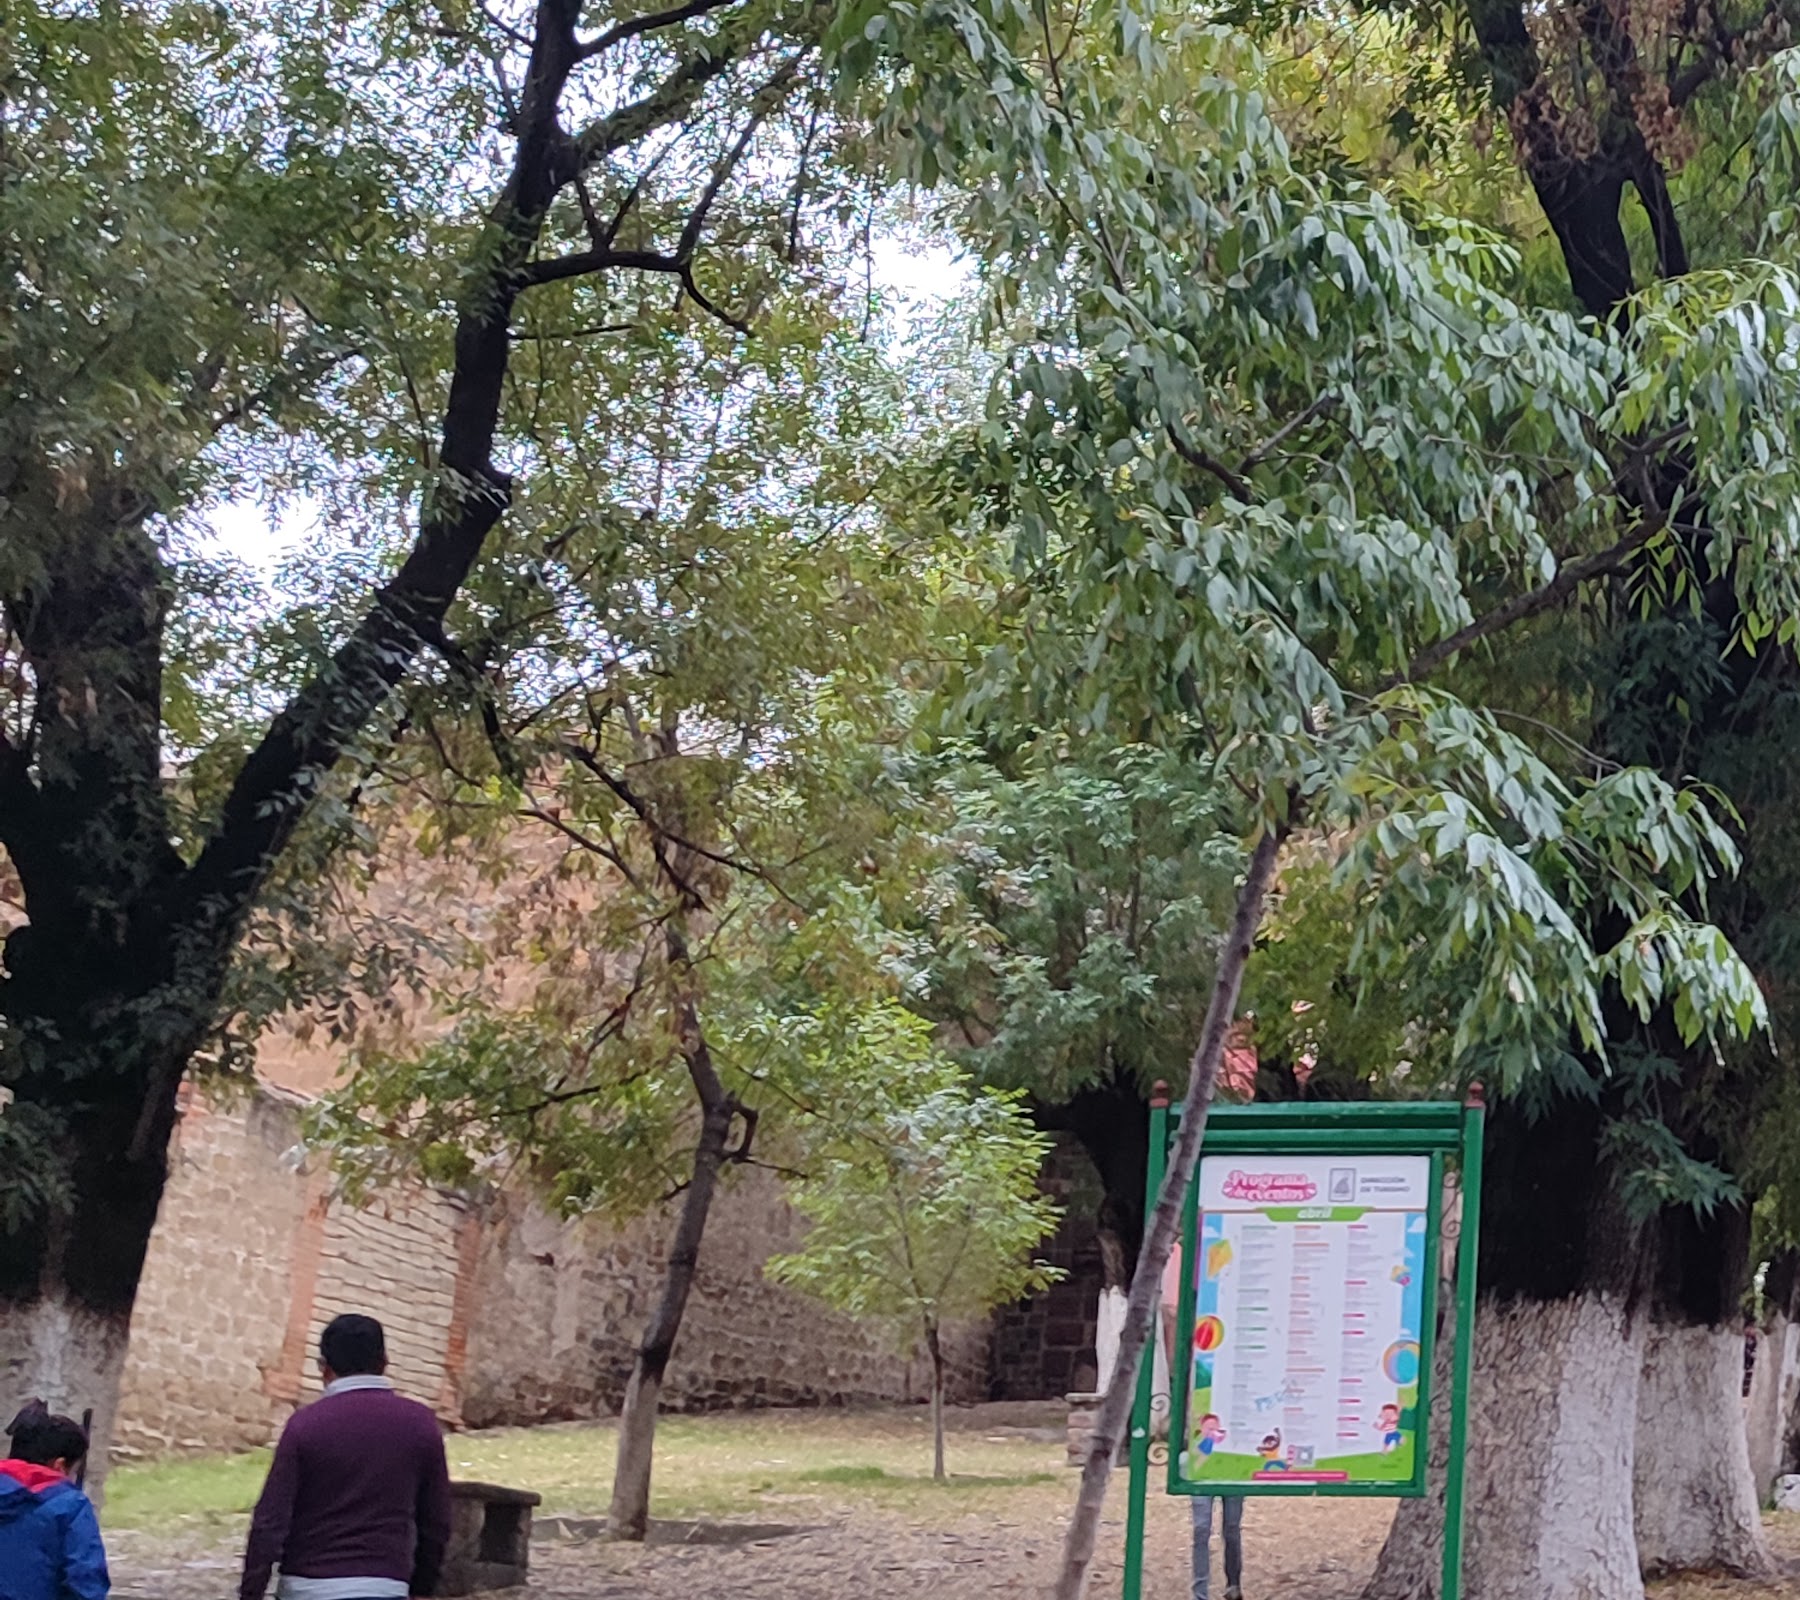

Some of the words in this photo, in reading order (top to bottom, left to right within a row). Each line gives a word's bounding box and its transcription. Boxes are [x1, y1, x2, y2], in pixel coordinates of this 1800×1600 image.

[1230, 1170, 1308, 1189] Programa
[1247, 1187, 1305, 1201] eventos
[1297, 1208, 1332, 1219] abril
